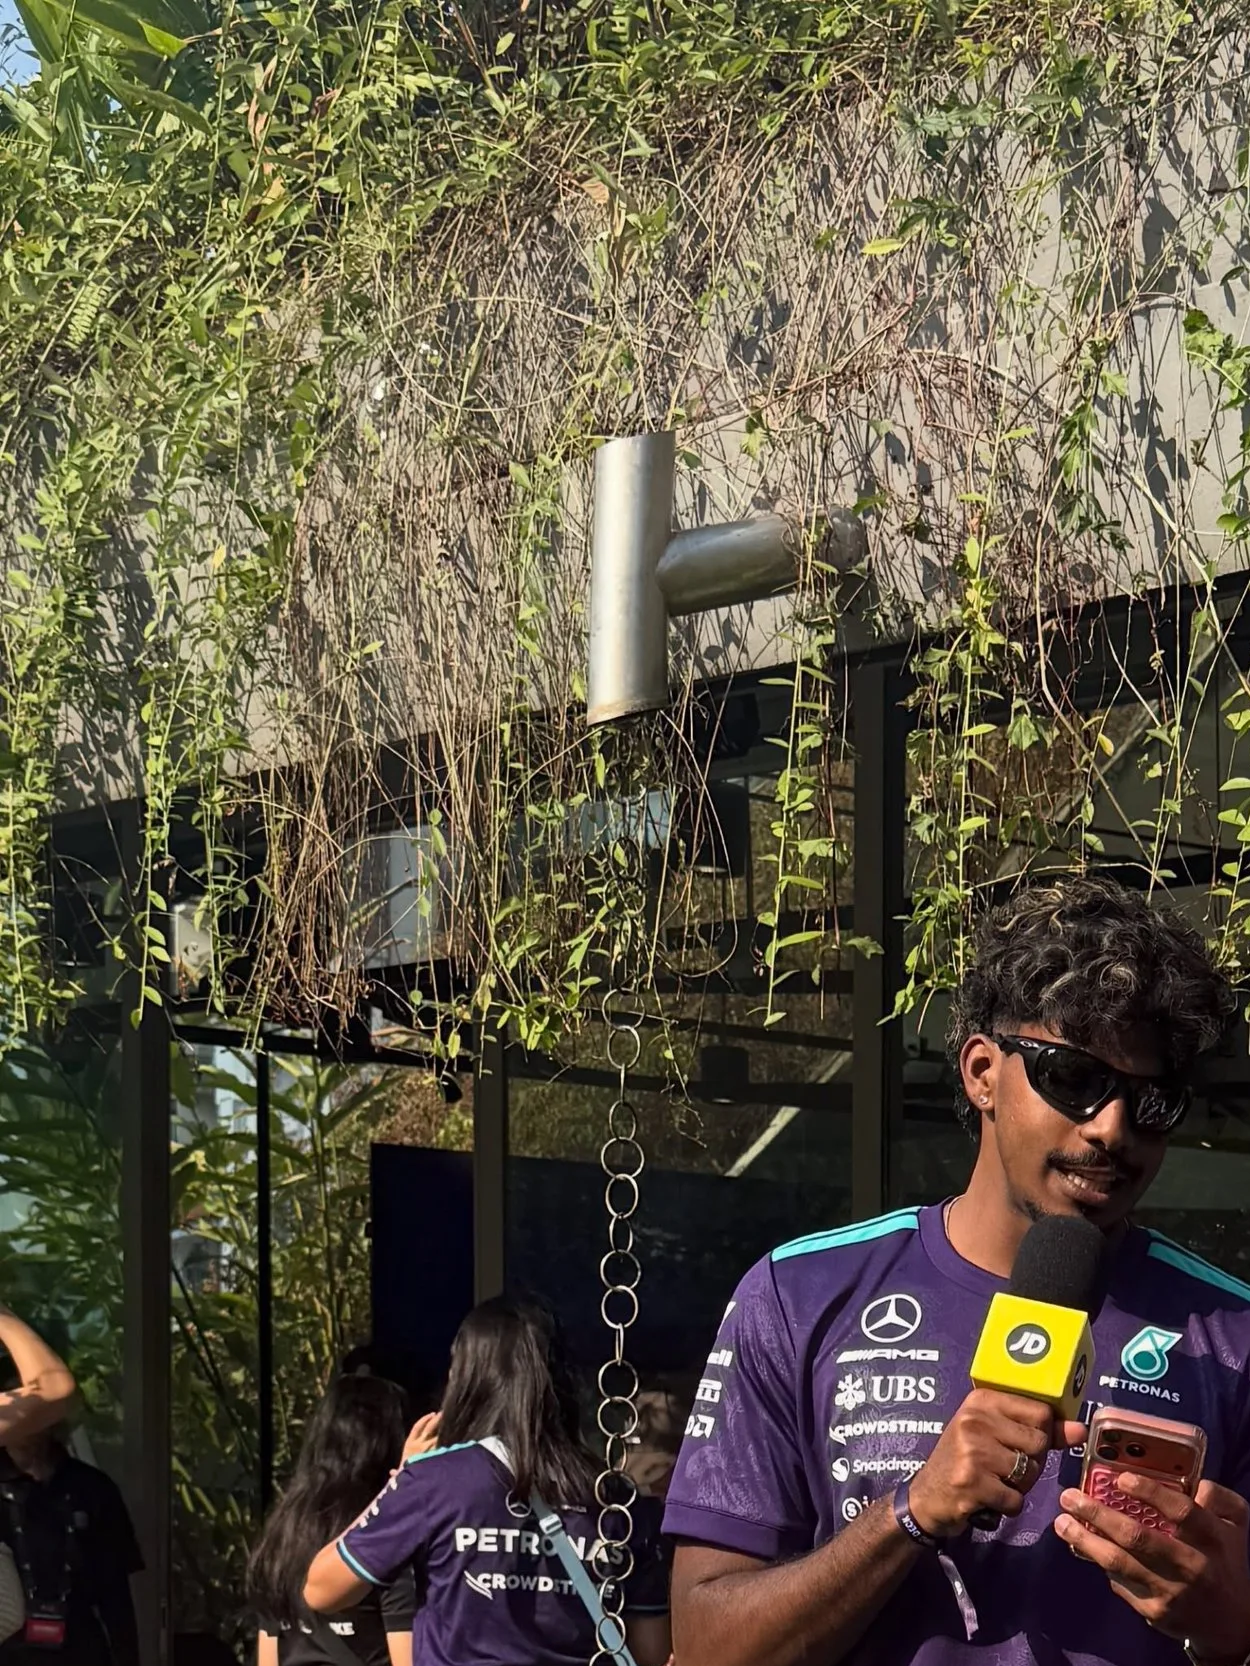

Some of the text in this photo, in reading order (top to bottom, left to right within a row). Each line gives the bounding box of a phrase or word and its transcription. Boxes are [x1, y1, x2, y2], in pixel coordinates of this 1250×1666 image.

[869, 1348, 940, 1362] AMG
[1009, 1331, 1047, 1356] JD
[871, 1375, 937, 1403] UBS
[1098, 1374, 1181, 1404] PETRONAS
[835, 1420, 944, 1438] CROWDSTRIKE
[852, 1456, 927, 1483] Snapdrago
[454, 1527, 625, 1565] PETRONAS
[477, 1573, 616, 1599] CROWDSTE
